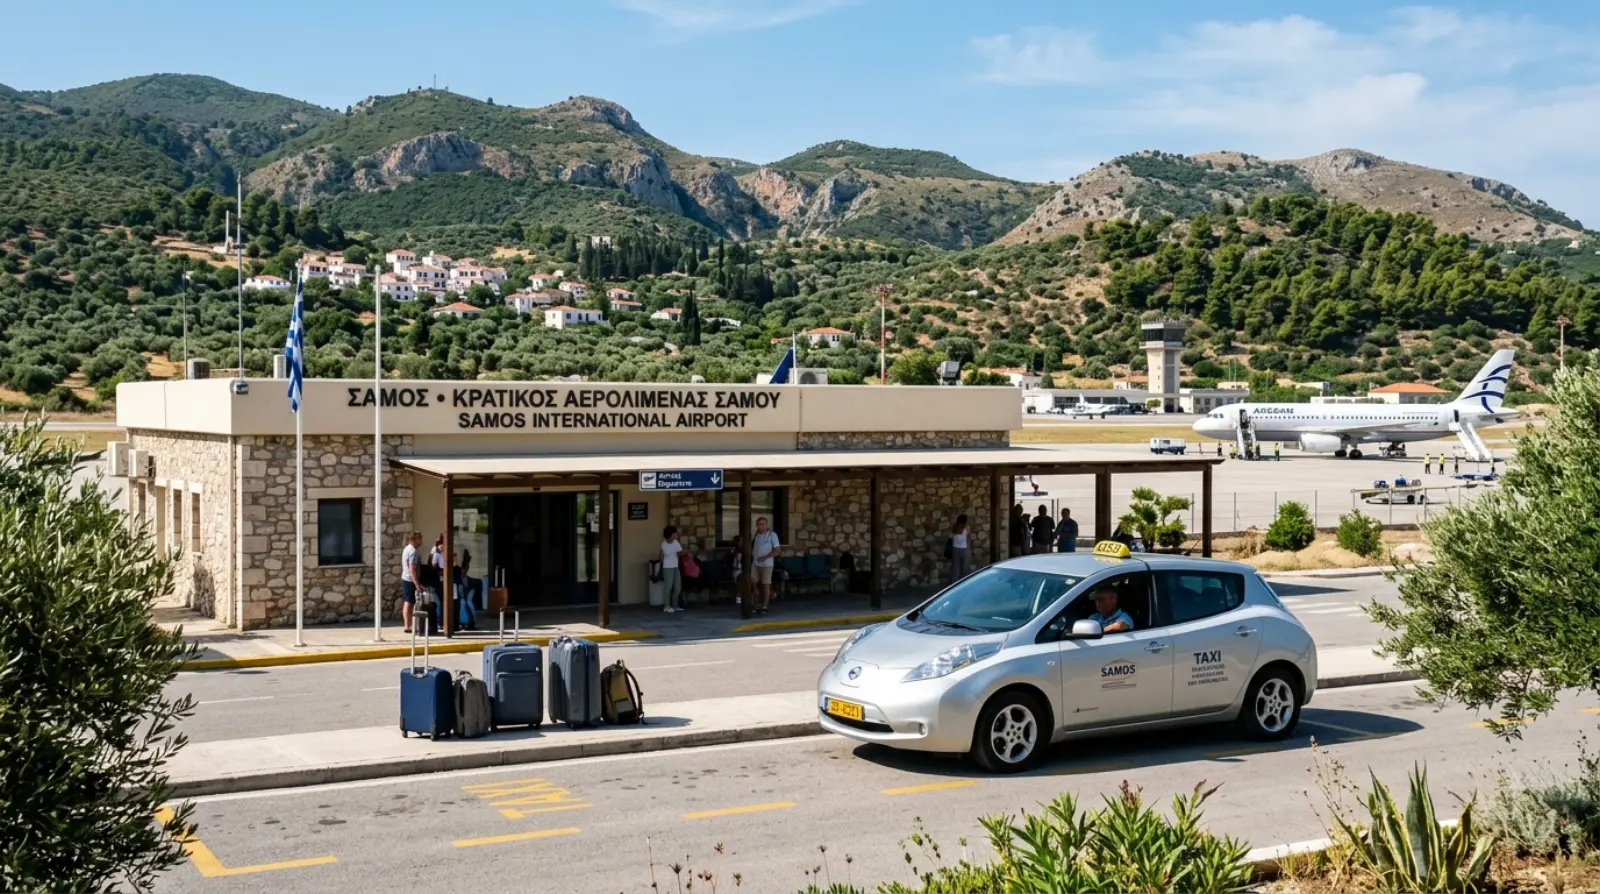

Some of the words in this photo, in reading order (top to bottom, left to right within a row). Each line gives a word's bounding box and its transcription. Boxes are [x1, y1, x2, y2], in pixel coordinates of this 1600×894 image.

[348, 387, 430, 408] ΣΑΜΟΣ
[453, 388, 557, 409] ΚΡΑΤΙΚΟΣ
[563, 389, 709, 410] ΑΕΡΟΛΙΜΕΝΑΣ
[714, 390, 781, 410] ΣΑΜΟΥ
[458, 411, 527, 429] SAMOS
[532, 411, 671, 429] INTERNATIONAL
[675, 411, 748, 428] AIRPORT
[1193, 649, 1222, 665] TAXI
[1101, 664, 1136, 677] SAMOS
